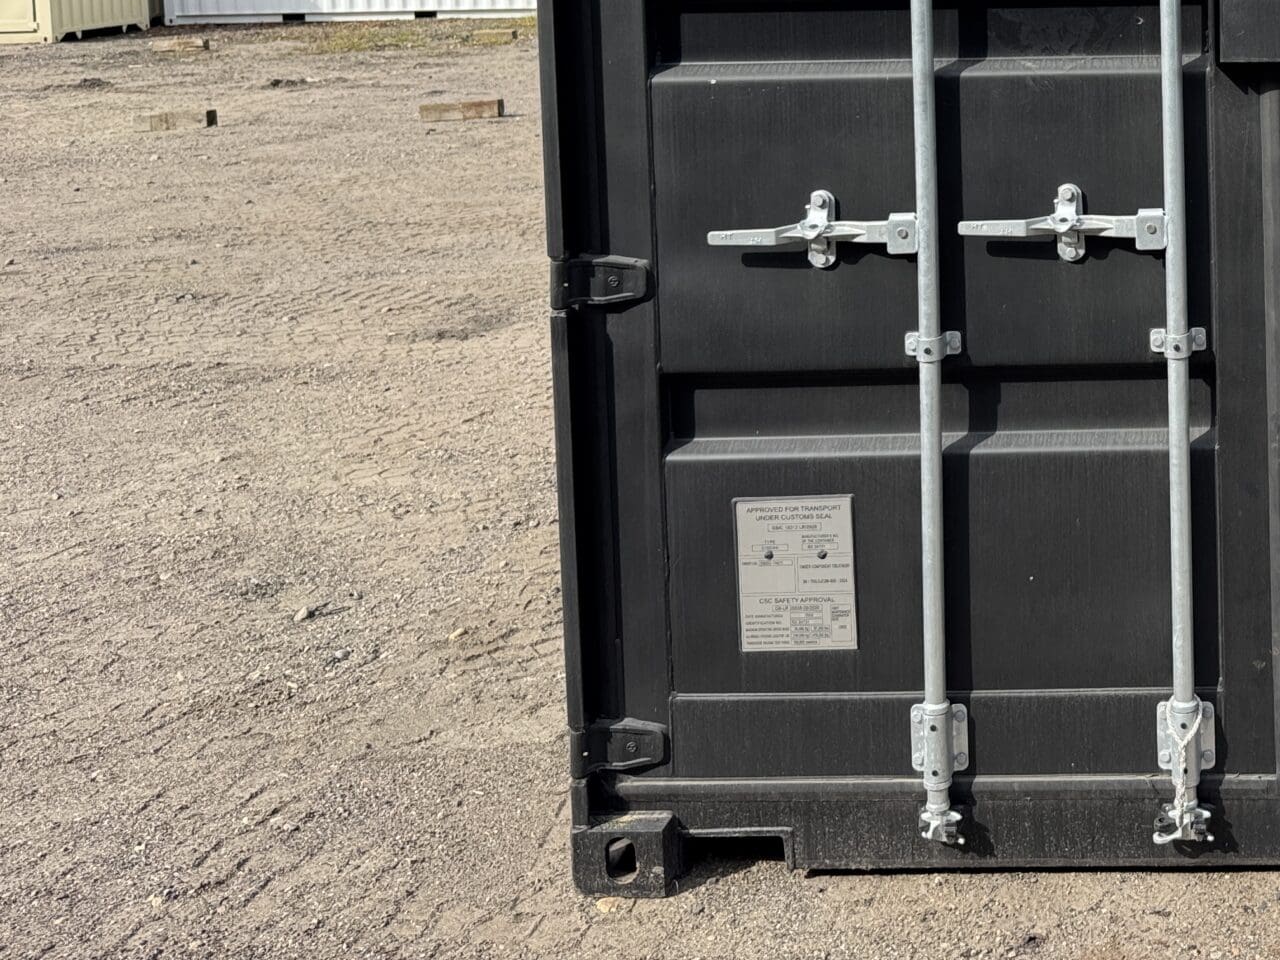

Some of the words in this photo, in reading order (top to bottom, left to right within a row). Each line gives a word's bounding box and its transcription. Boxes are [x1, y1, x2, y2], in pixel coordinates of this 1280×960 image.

[746, 506, 784, 514] APPROVED
[800, 504, 841, 512] TRANSPORT
[755, 514, 780, 522] UNDER
[780, 513, 815, 521] CUSTOMS
[800, 596, 835, 604] APPROVAL
